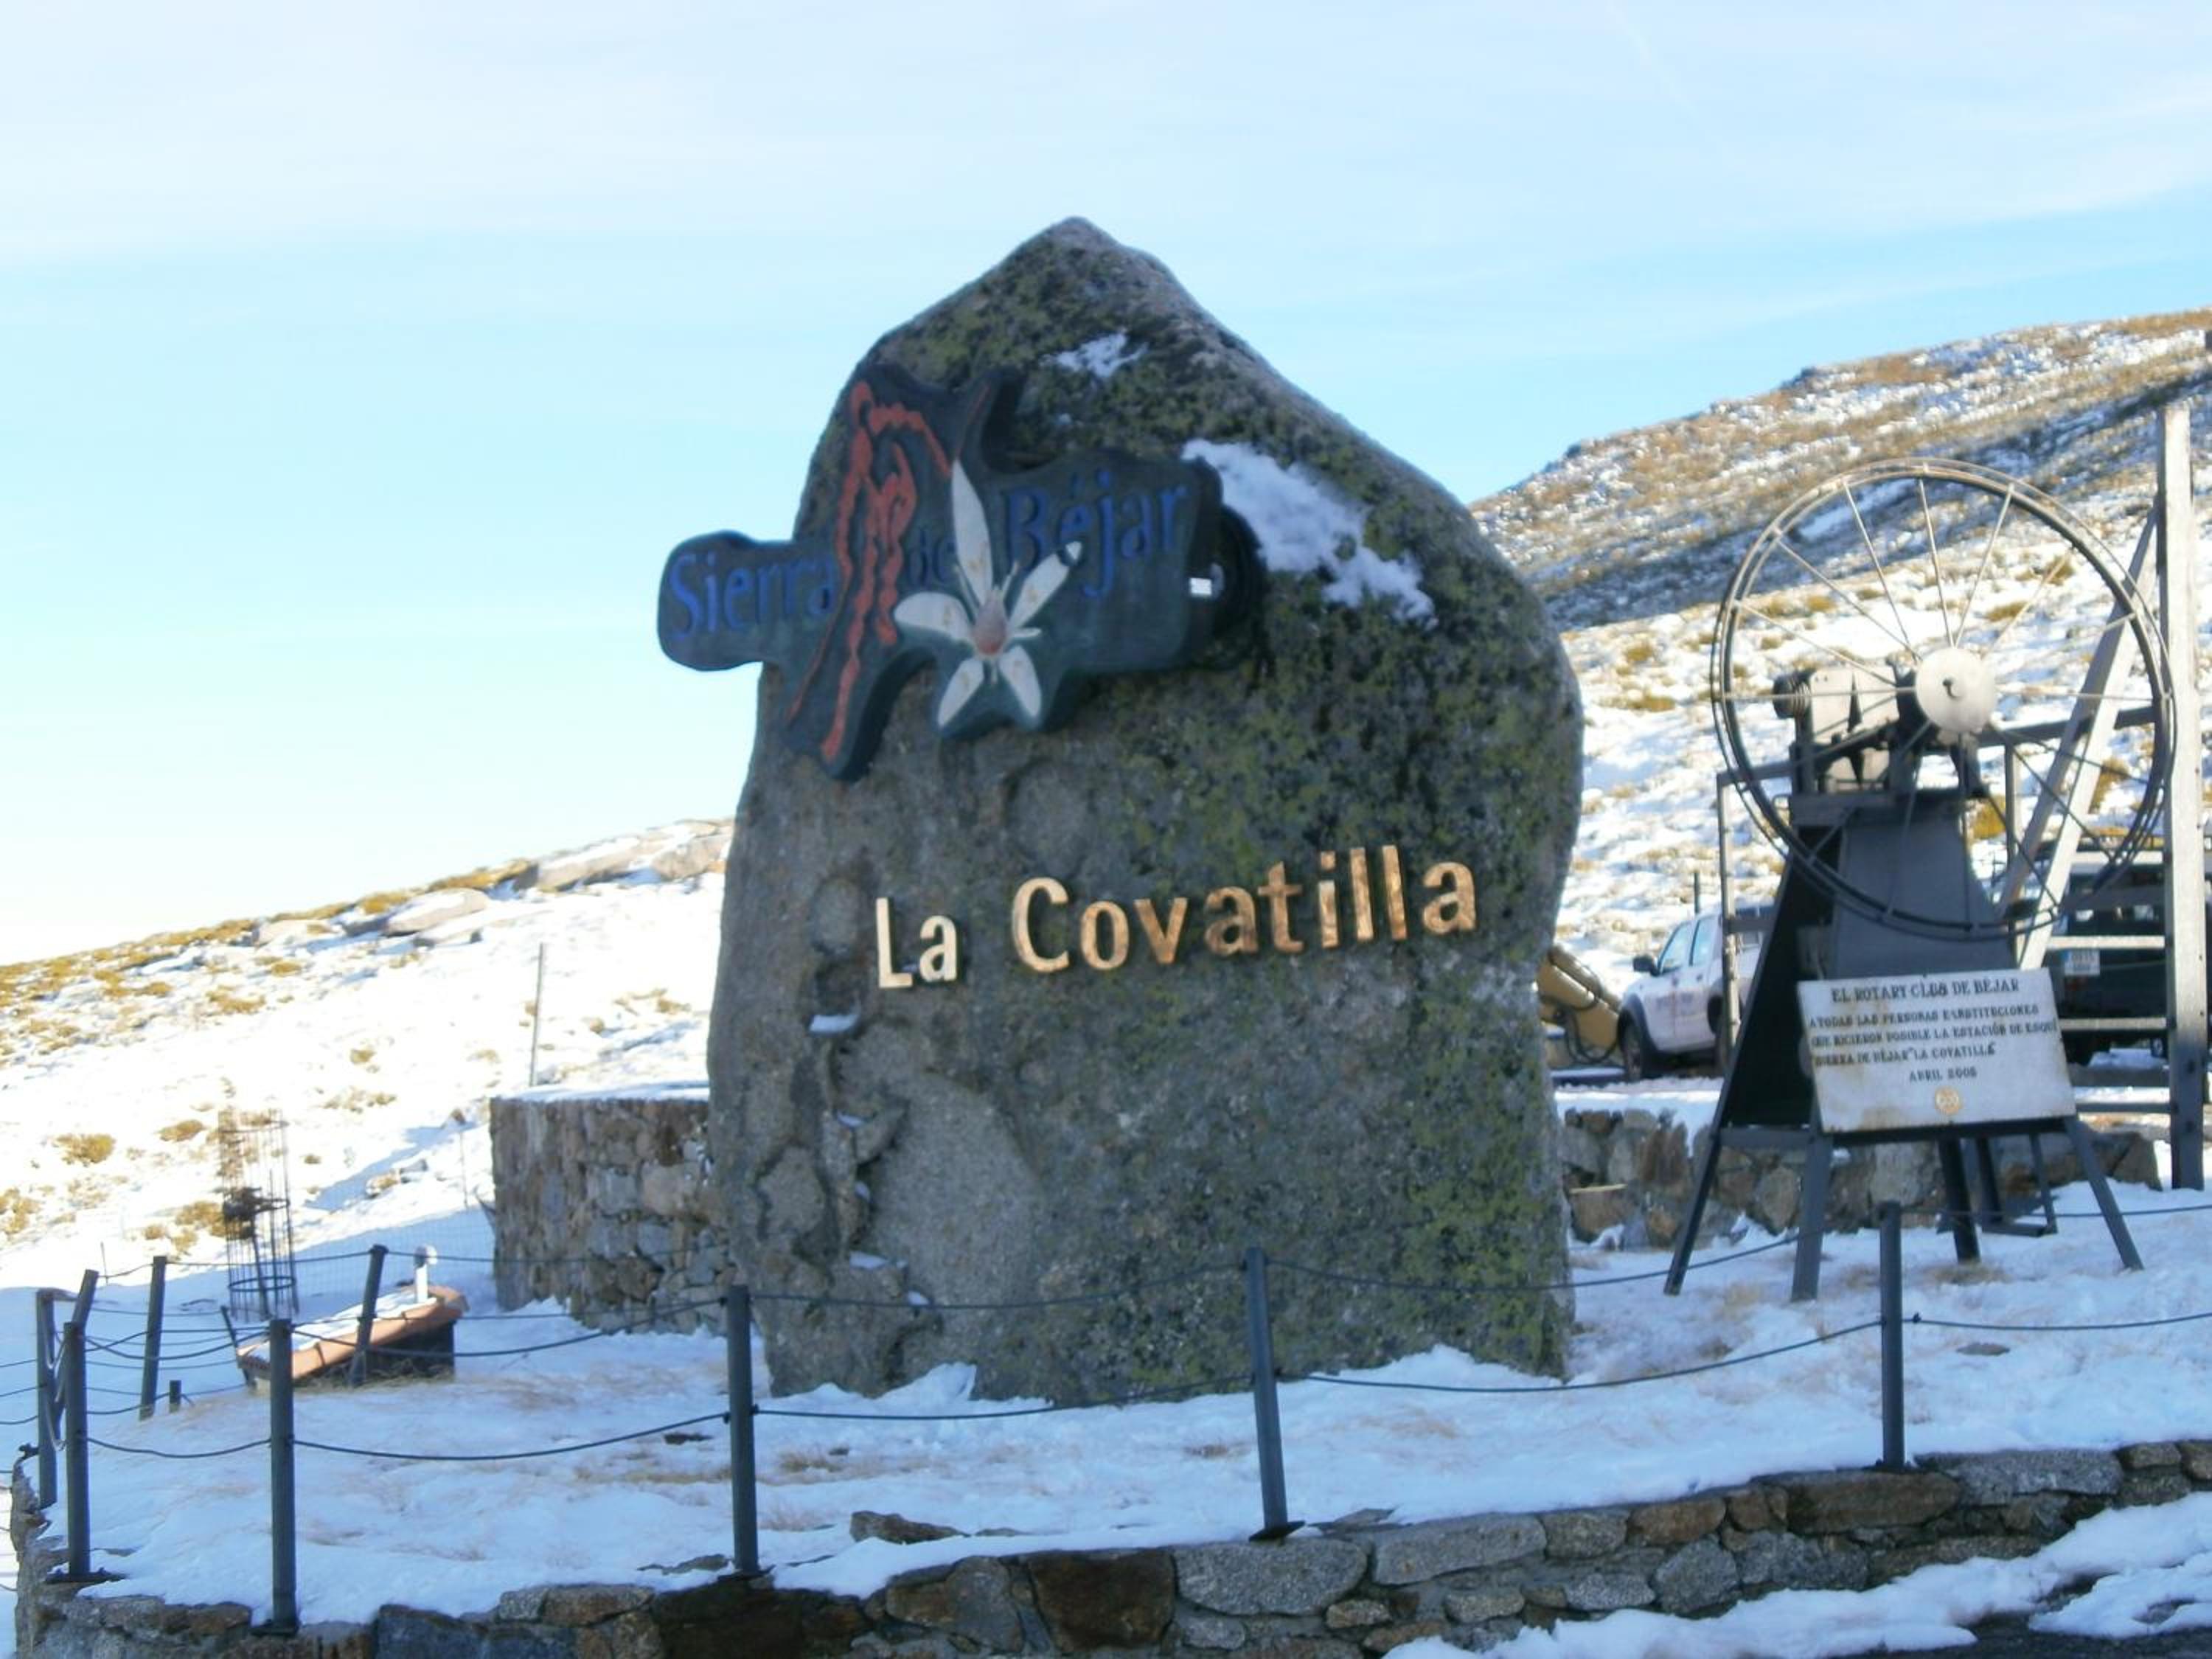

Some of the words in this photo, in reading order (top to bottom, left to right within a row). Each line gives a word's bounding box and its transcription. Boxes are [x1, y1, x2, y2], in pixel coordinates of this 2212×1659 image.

[667, 552, 833, 637] Sierra
[905, 529, 954, 584] de
[1006, 472, 1189, 593] Béjar
[875, 897, 957, 989] La
[1012, 845, 1475, 973] Covatilla
[1832, 988, 1851, 1003] EL
[1952, 979, 1970, 994] DE
